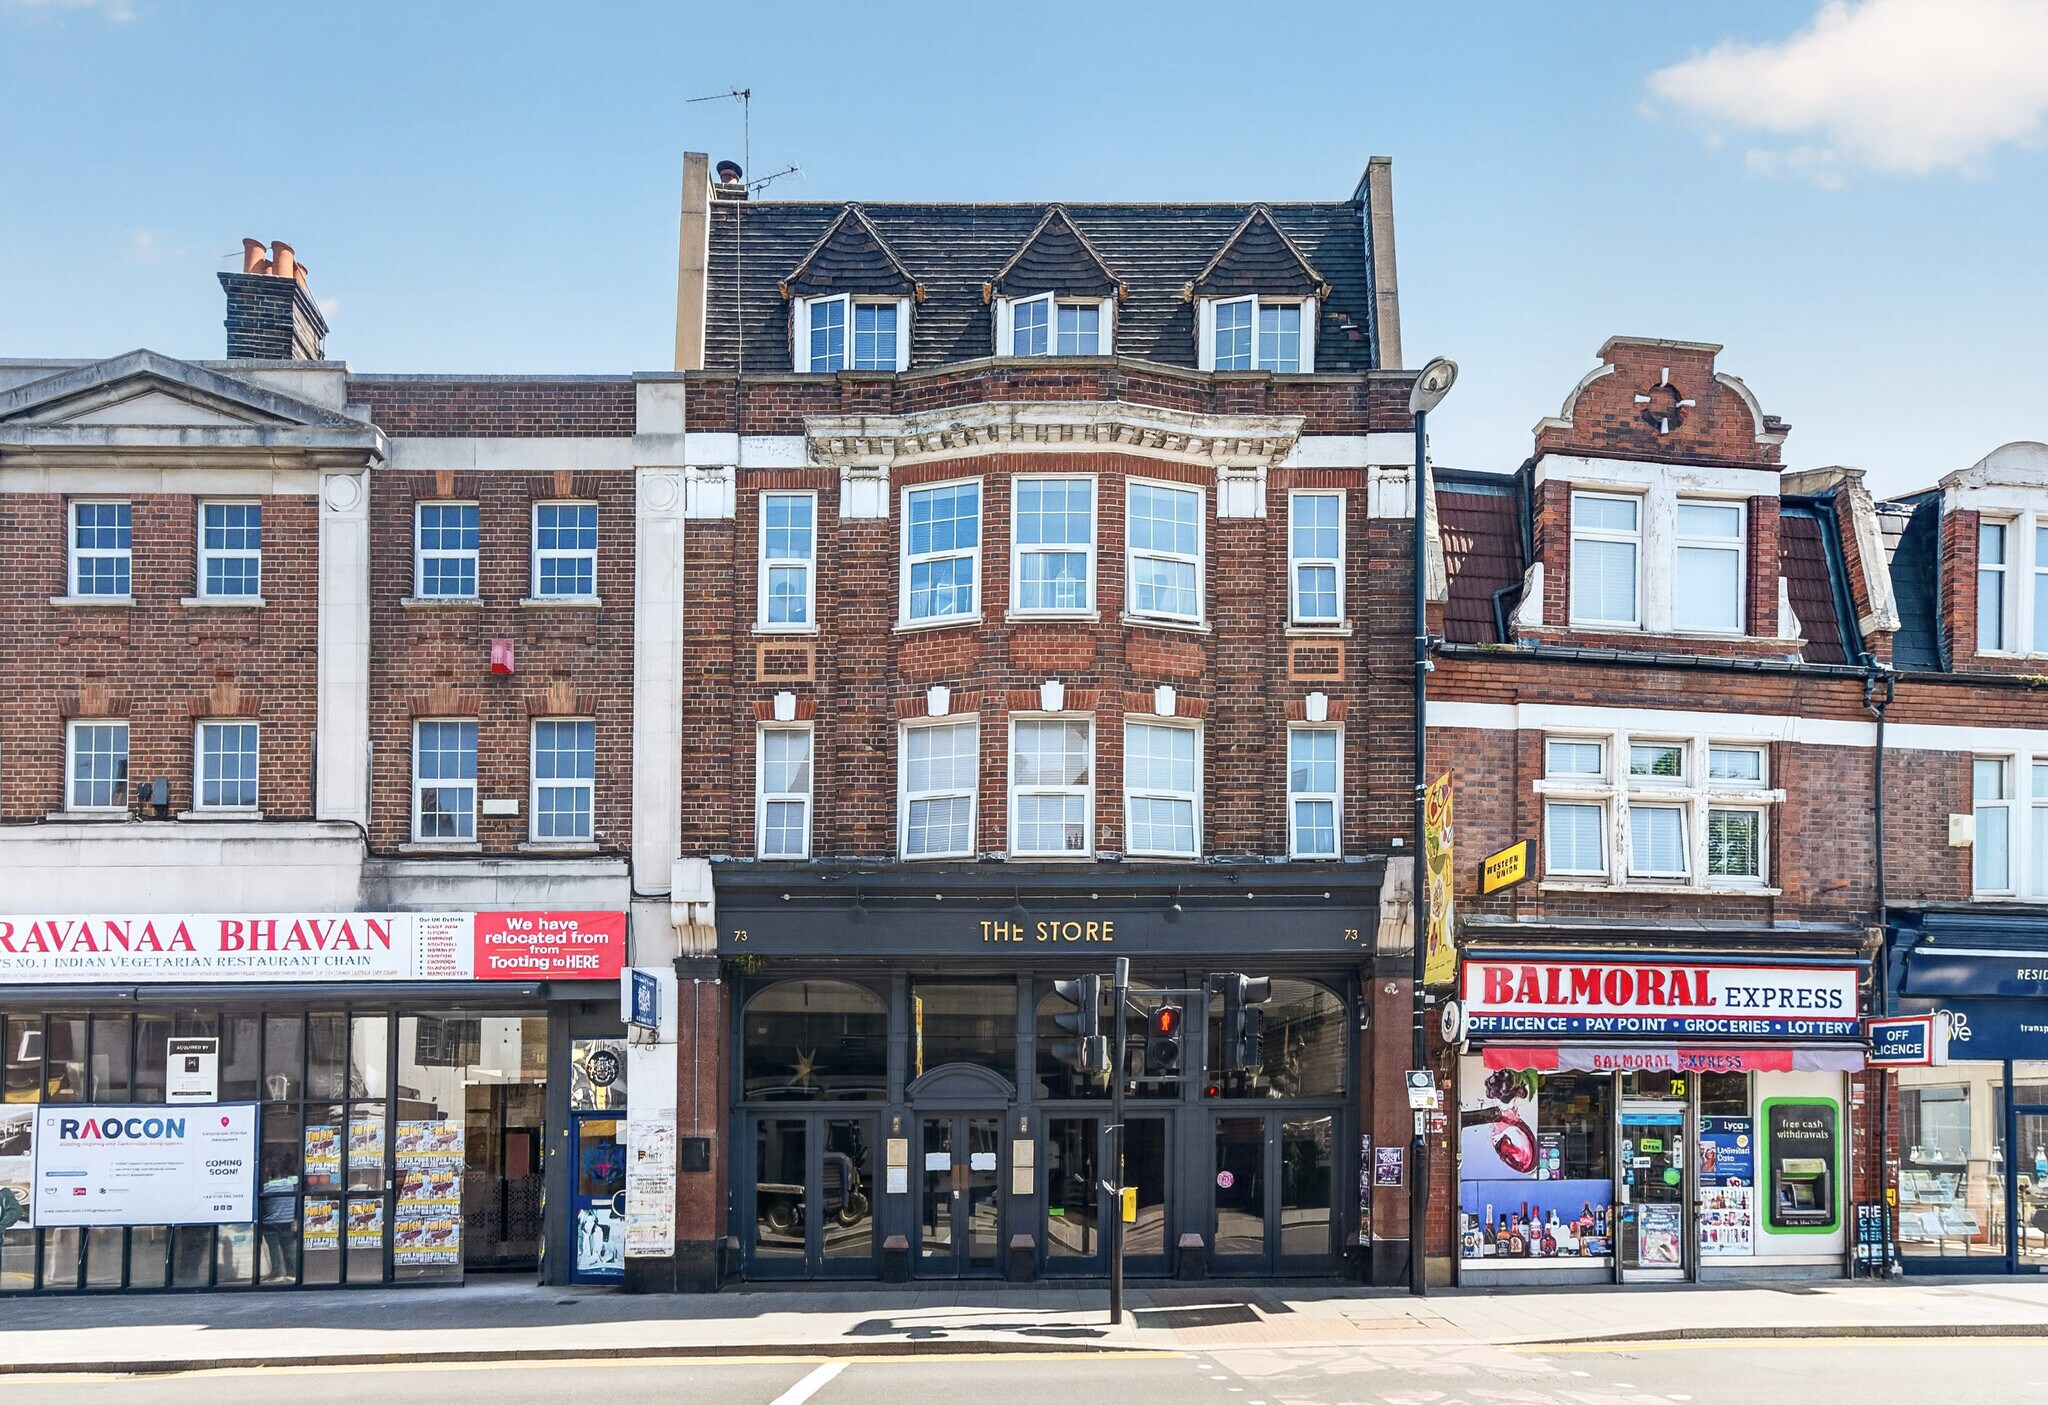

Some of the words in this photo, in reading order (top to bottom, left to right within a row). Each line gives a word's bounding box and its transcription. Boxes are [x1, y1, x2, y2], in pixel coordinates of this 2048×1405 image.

[1487, 855, 1518, 874] WESTERN
[1496, 864, 1518, 878] UNION
[506, 918, 532, 930] We
[538, 917, 578, 930] have
[0, 920, 197, 953] RAVANAA
[217, 919, 395, 951] BHAVAN
[485, 931, 566, 944] relocated
[570, 930, 609, 944] from
[734, 930, 748, 942] 73
[980, 921, 1024, 942] THE
[1036, 921, 1114, 942] STORE
[1344, 929, 1358, 940] 73
[530, 944, 560, 954] from
[54, 957, 106, 968] INDIAN
[110, 956, 212, 968] VEGETARIAN
[217, 956, 320, 967] RESTAURANT
[324, 956, 372, 966] CHAIN
[488, 955, 550, 970] Tooting
[553, 957, 565, 967] to
[566, 954, 600, 969] HERE
[1482, 966, 1716, 1006] BALMORAL
[1725, 986, 1842, 1009] EXPRESS
[1469, 1016, 1497, 1030] OFF
[1501, 1016, 1567, 1031] LICENCE
[1685, 1019, 1770, 1033] GROCERIES
[1788, 1022, 1854, 1034] LOTTERY
[1886, 1030, 1910, 1042] OFF
[1875, 1044, 1922, 1056] LICENCE
[1594, 1055, 1672, 1068] BALMORAL
[1680, 1056, 1742, 1068] EXPRESS
[1670, 1080, 1685, 1096] 75
[60, 1118, 186, 1140] RAOCON
[1724, 1122, 1744, 1131] Lyca
[1782, 1120, 1800, 1128] free
[1802, 1120, 1823, 1128] cash
[1777, 1130, 1828, 1139] withdrawals
[206, 1160, 242, 1168] COMING
[210, 1168, 238, 1176] SOON!
